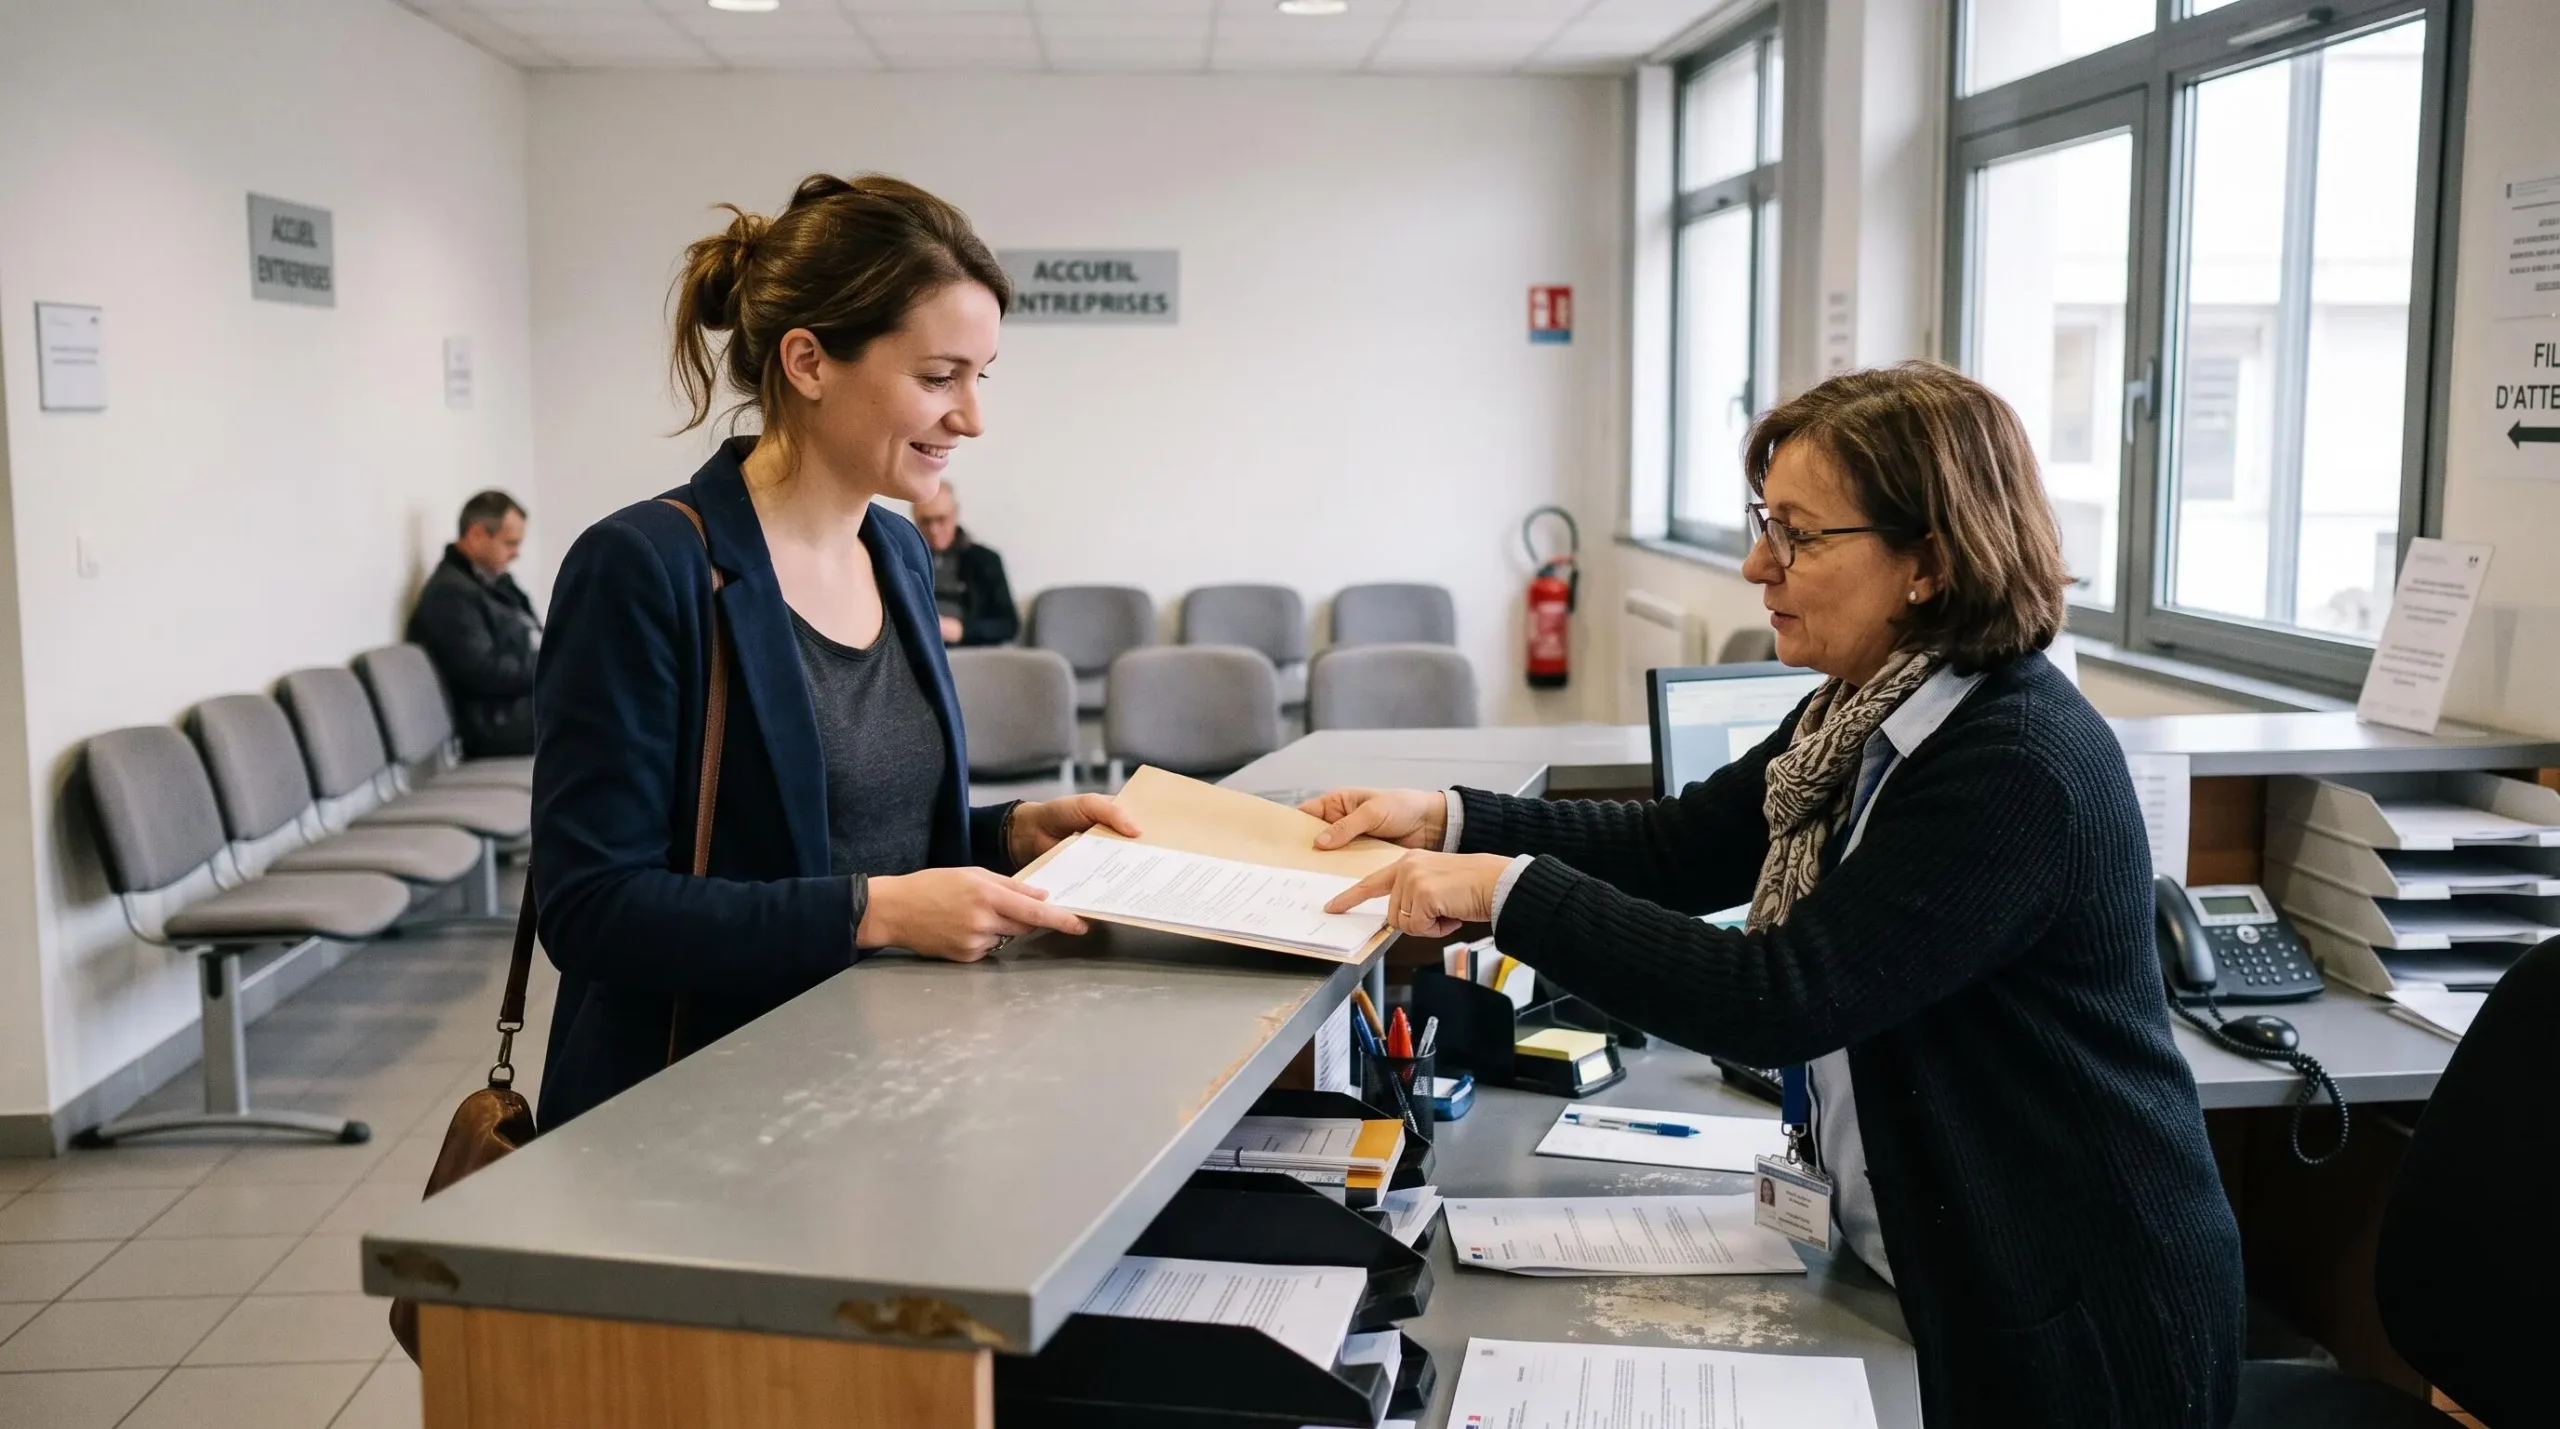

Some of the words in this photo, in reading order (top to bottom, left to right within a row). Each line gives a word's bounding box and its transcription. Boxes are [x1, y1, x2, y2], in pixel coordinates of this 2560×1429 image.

[271, 212, 318, 249] ACCUEIL
[257, 254, 332, 292] ENTREPRISES
[1033, 260, 1139, 282] ACCUEIL
[1007, 292, 1168, 315] NTREPRISES
[2534, 342, 2560, 368] FIL
[2495, 384, 2560, 410] D'ATTE
